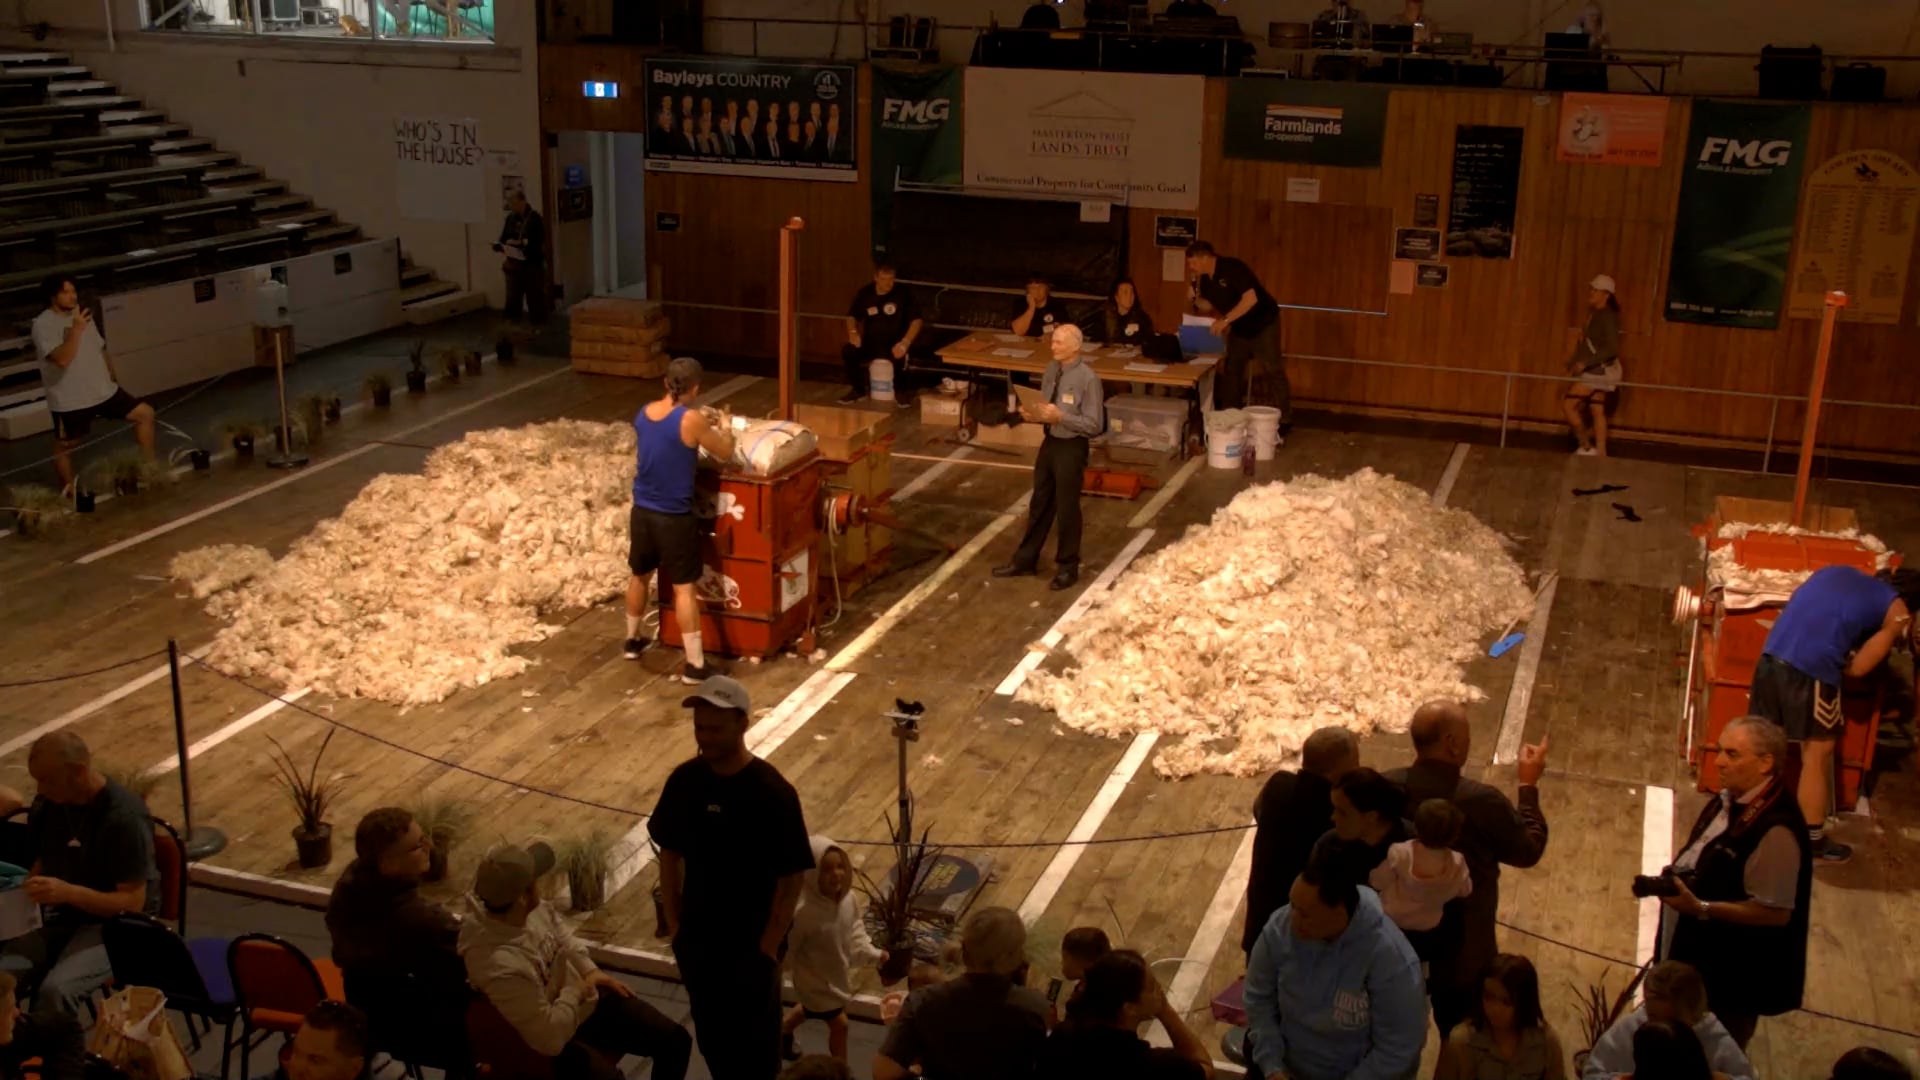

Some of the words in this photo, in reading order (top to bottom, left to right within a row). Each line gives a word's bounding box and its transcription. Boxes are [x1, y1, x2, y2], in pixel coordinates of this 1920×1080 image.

[652, 69, 714, 88] Bayleys
[716, 73, 792, 89] COUNTRY
[883, 97, 951, 123] FMG
[393, 118, 442, 143] WHO'S
[449, 123, 477, 146] IN
[1264, 116, 1342, 137] Farmlands
[1032, 141, 1080, 154] LANDS
[1085, 143, 1129, 157] TRUST
[1698, 136, 1793, 168] FMG
[1037, 176, 1077, 190] Property
[1080, 178, 1094, 189] for
[1157, 182, 1187, 193] Good
